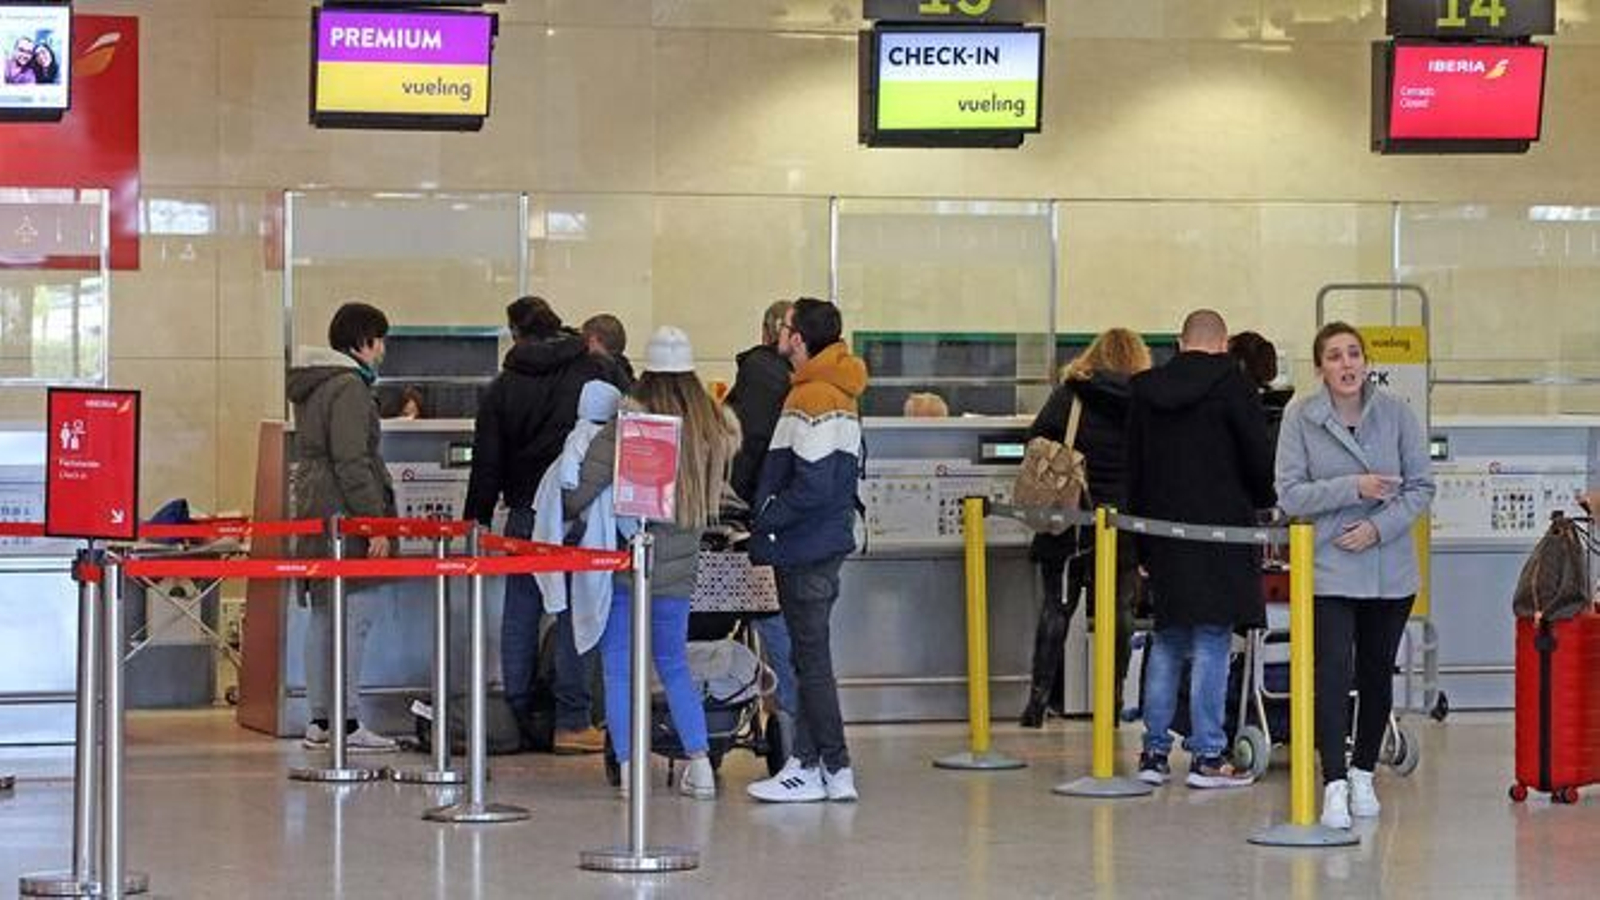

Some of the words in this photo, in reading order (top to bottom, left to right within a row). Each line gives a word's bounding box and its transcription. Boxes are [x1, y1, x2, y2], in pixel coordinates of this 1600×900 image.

[1436, 0, 1506, 27] 14
[330, 27, 442, 48] PREMIUM
[888, 46, 999, 65] CHECK-IN
[1428, 59, 1485, 72] IBERIA
[402, 77, 472, 101] vueling
[958, 93, 1025, 117] vueling
